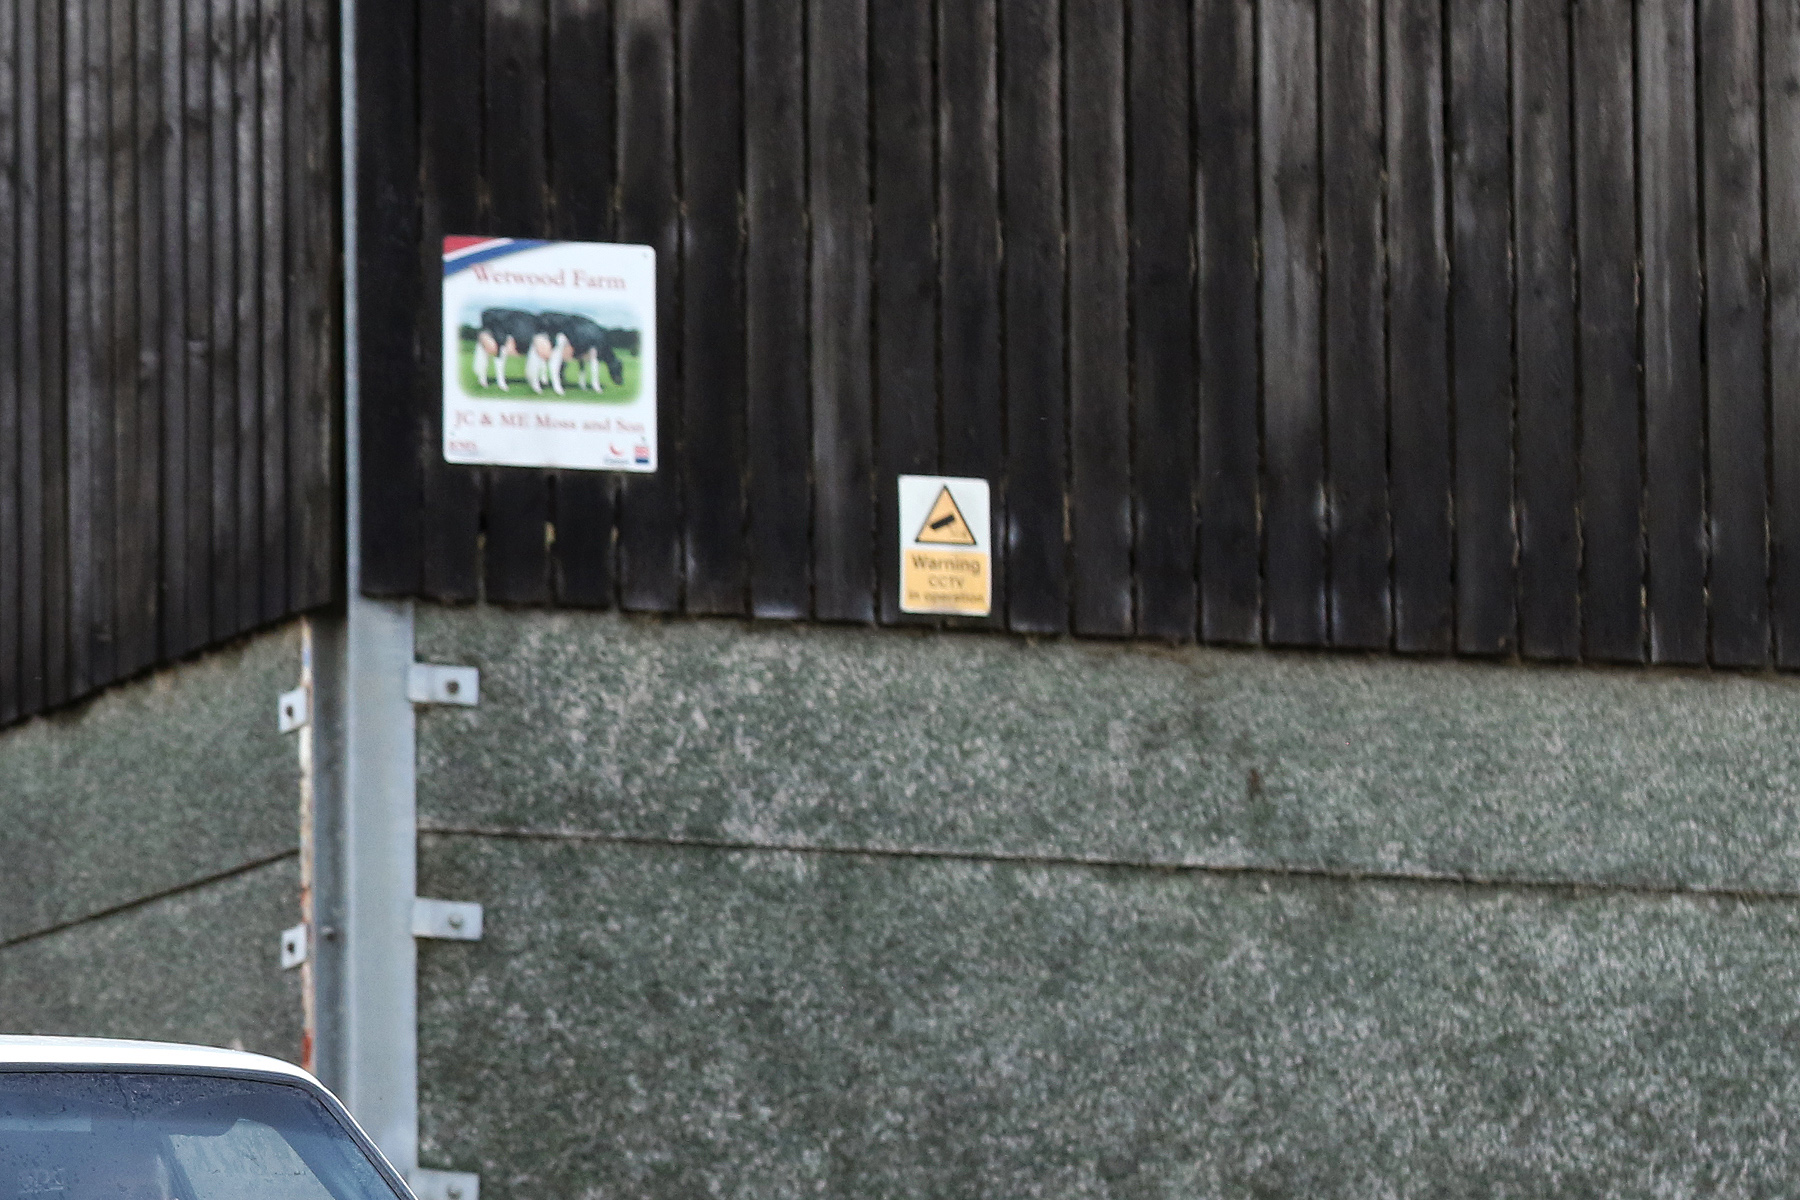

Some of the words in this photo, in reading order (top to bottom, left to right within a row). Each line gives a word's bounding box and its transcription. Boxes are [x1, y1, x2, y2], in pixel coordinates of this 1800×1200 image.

[572, 268, 627, 290] Farm
[912, 554, 981, 577] Warning
[928, 574, 964, 589] CCTV
